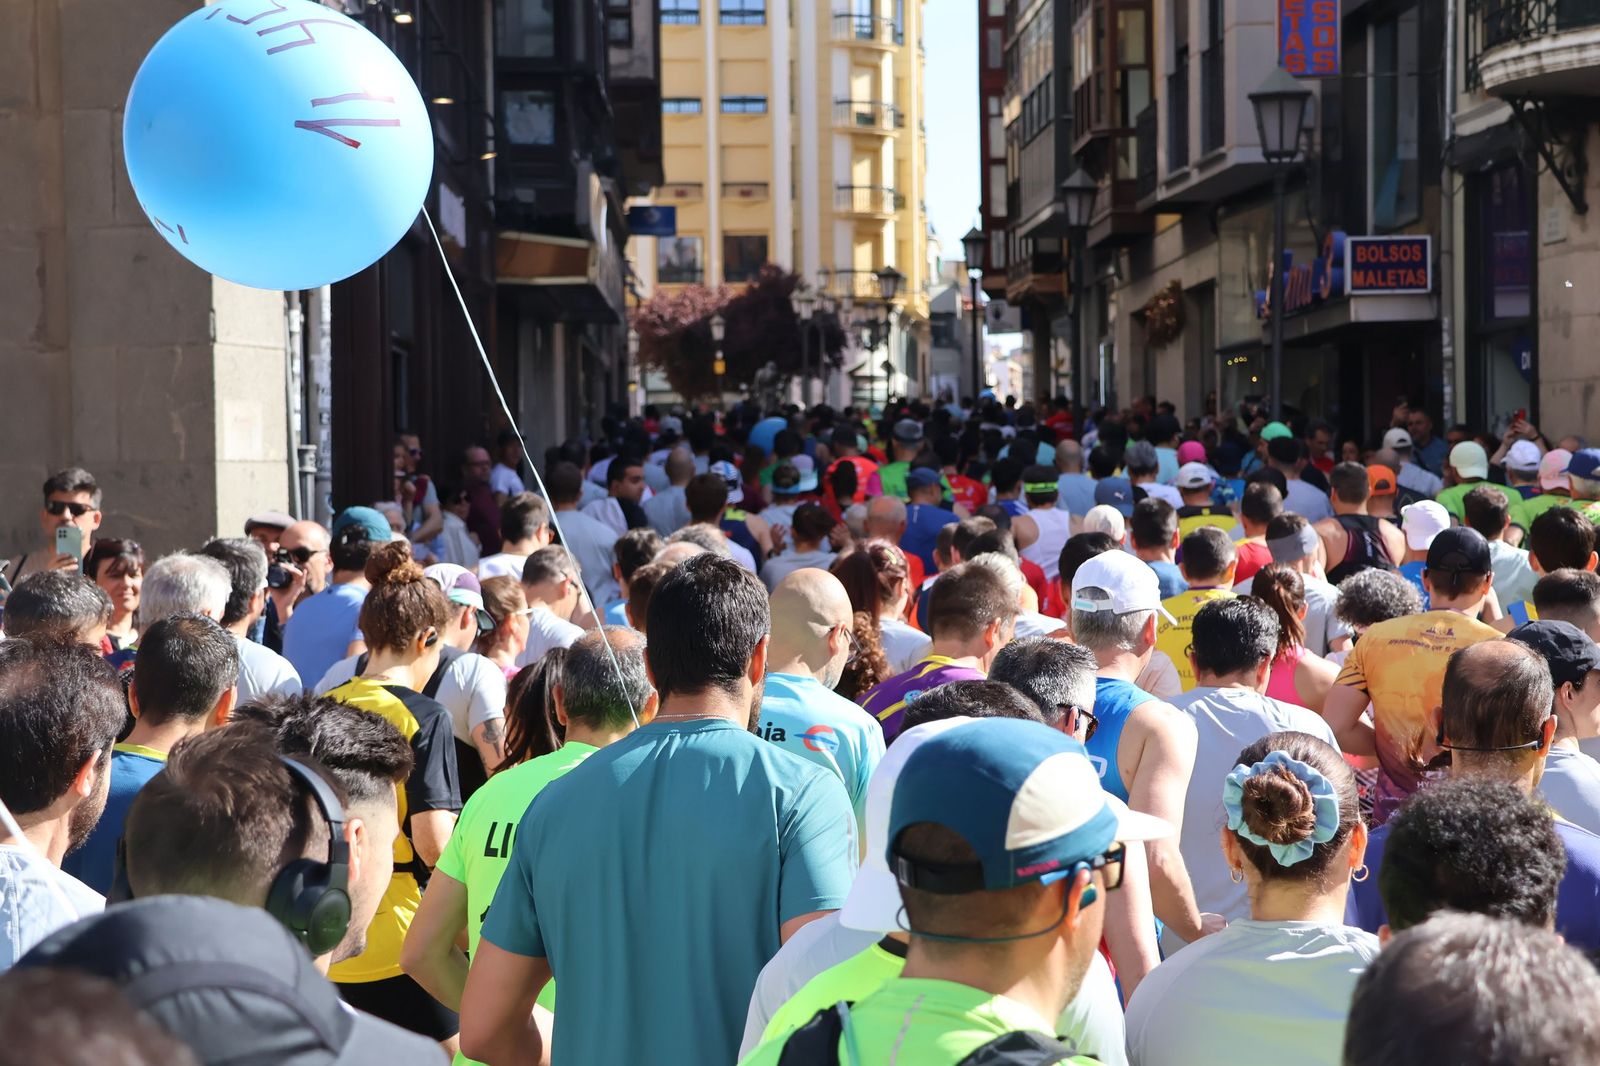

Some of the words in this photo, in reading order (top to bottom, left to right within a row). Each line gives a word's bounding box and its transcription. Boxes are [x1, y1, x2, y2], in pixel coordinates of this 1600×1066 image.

[1356, 244, 1422, 262] BOLSOS
[1352, 268, 1426, 288] MALETAS
[484, 821, 520, 858] LI
